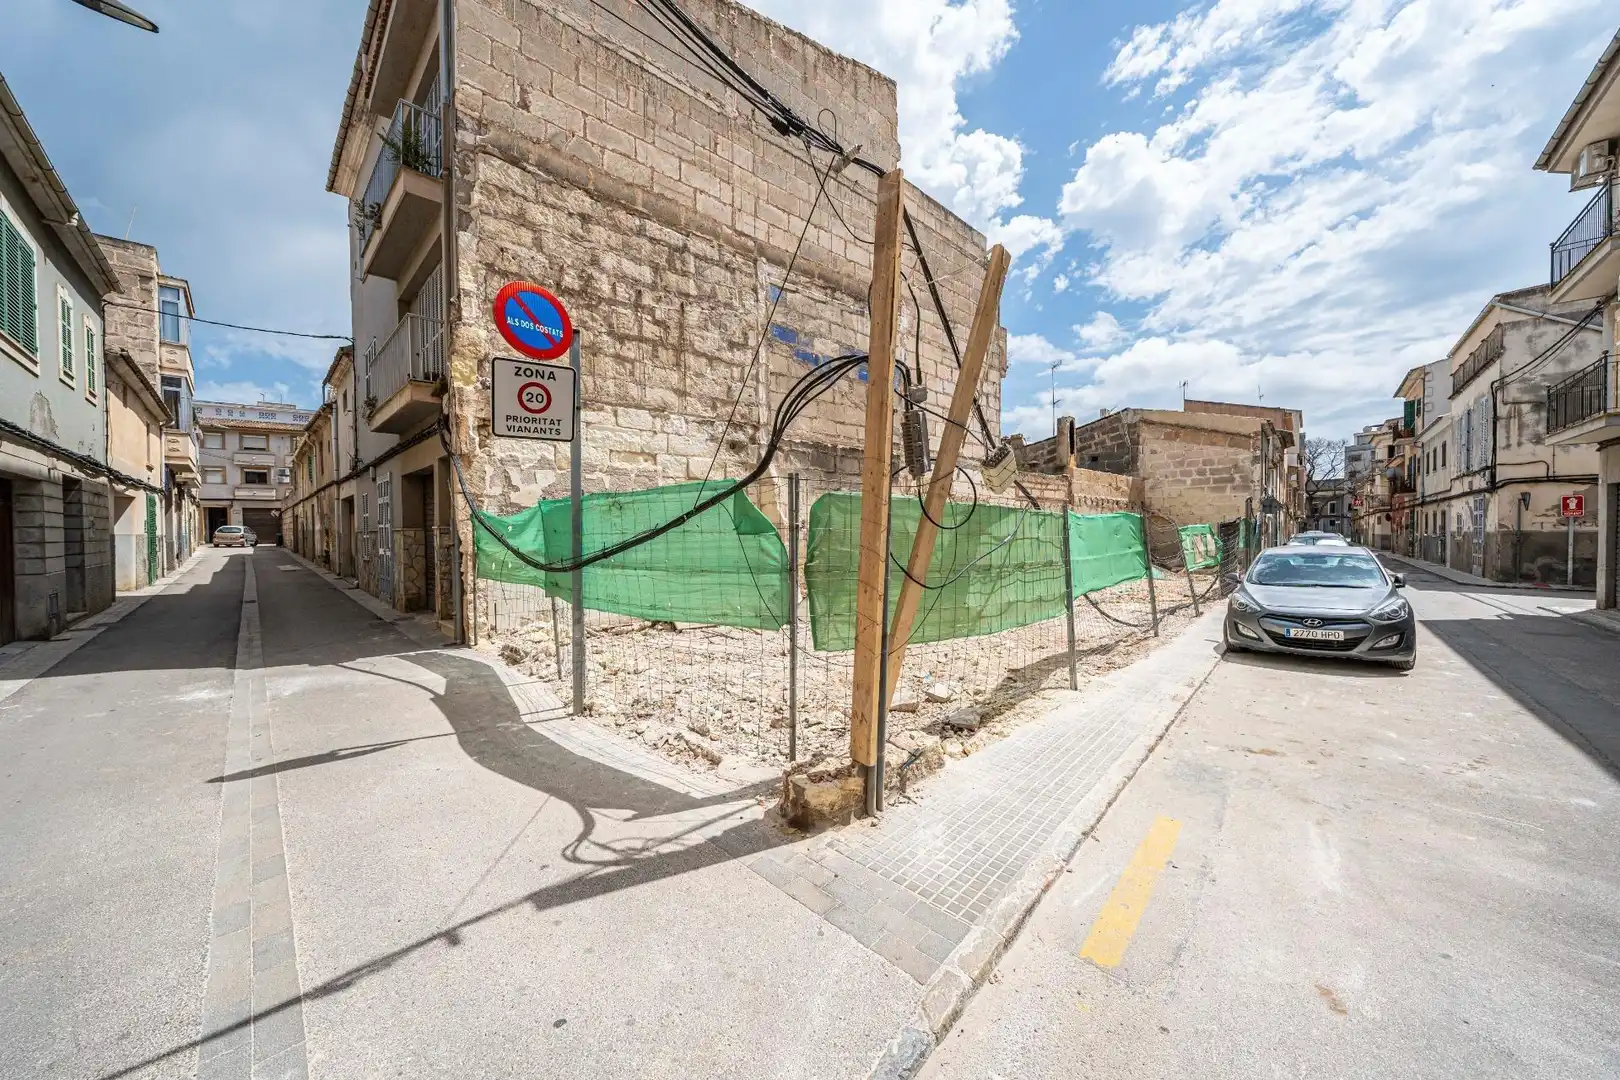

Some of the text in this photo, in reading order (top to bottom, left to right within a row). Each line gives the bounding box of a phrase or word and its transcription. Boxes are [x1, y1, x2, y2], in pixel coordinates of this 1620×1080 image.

[507, 315, 564, 338] ALS DOS COSTATS
[514, 366, 557, 381] ZONA
[525, 391, 545, 404] 20
[505, 414, 563, 427] PRIORITAT
[506, 424, 562, 436] VIANANTS
[1293, 629, 1318, 639] 2770
